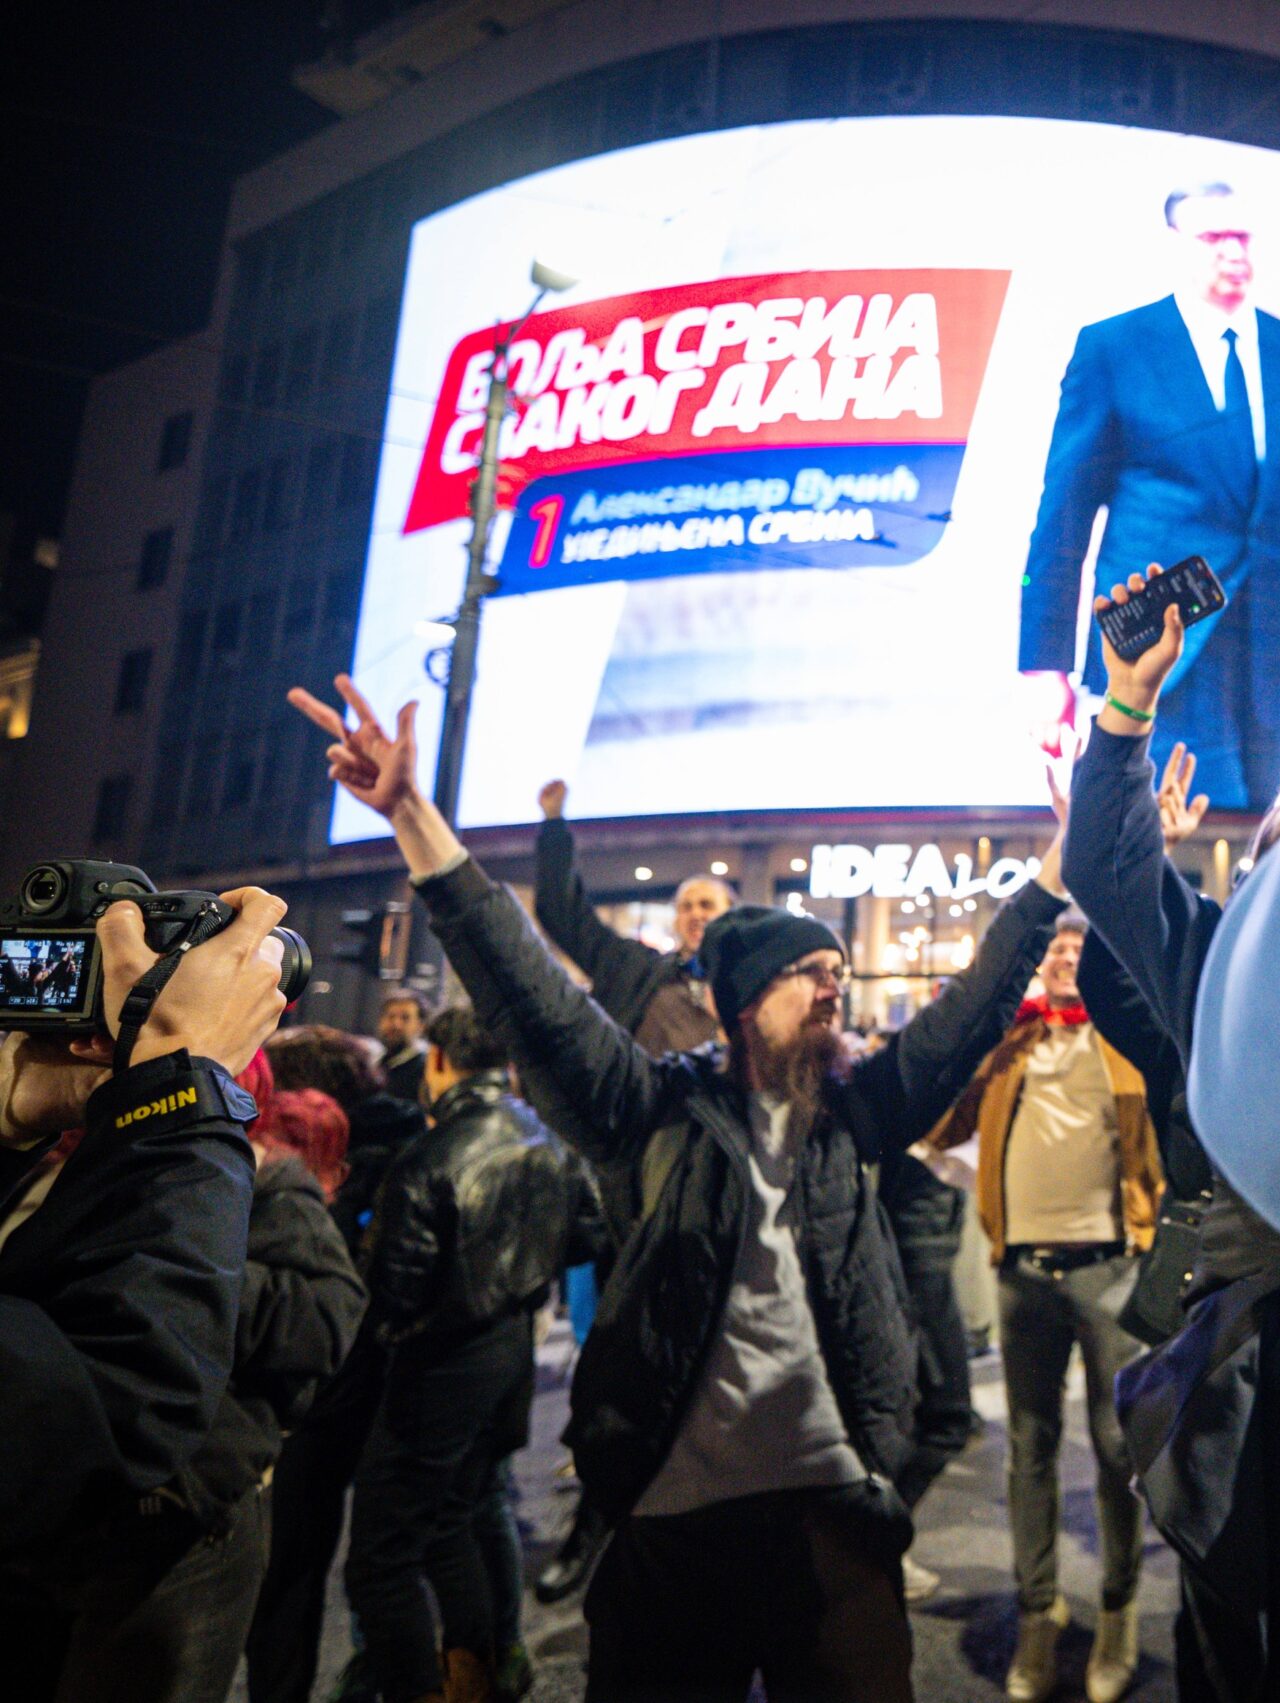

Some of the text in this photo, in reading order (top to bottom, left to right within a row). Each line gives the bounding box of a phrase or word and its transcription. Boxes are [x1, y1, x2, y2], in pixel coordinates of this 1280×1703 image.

[456, 293, 939, 415] БОЉА СРБИЈА
[691, 354, 943, 437] ДАНА
[570, 465, 920, 525] Александар Вучић
[528, 494, 565, 568] 1
[748, 508, 875, 545] СРБИЈА
[810, 844, 953, 898] IDEA
[115, 1087, 197, 1129] Nikon
